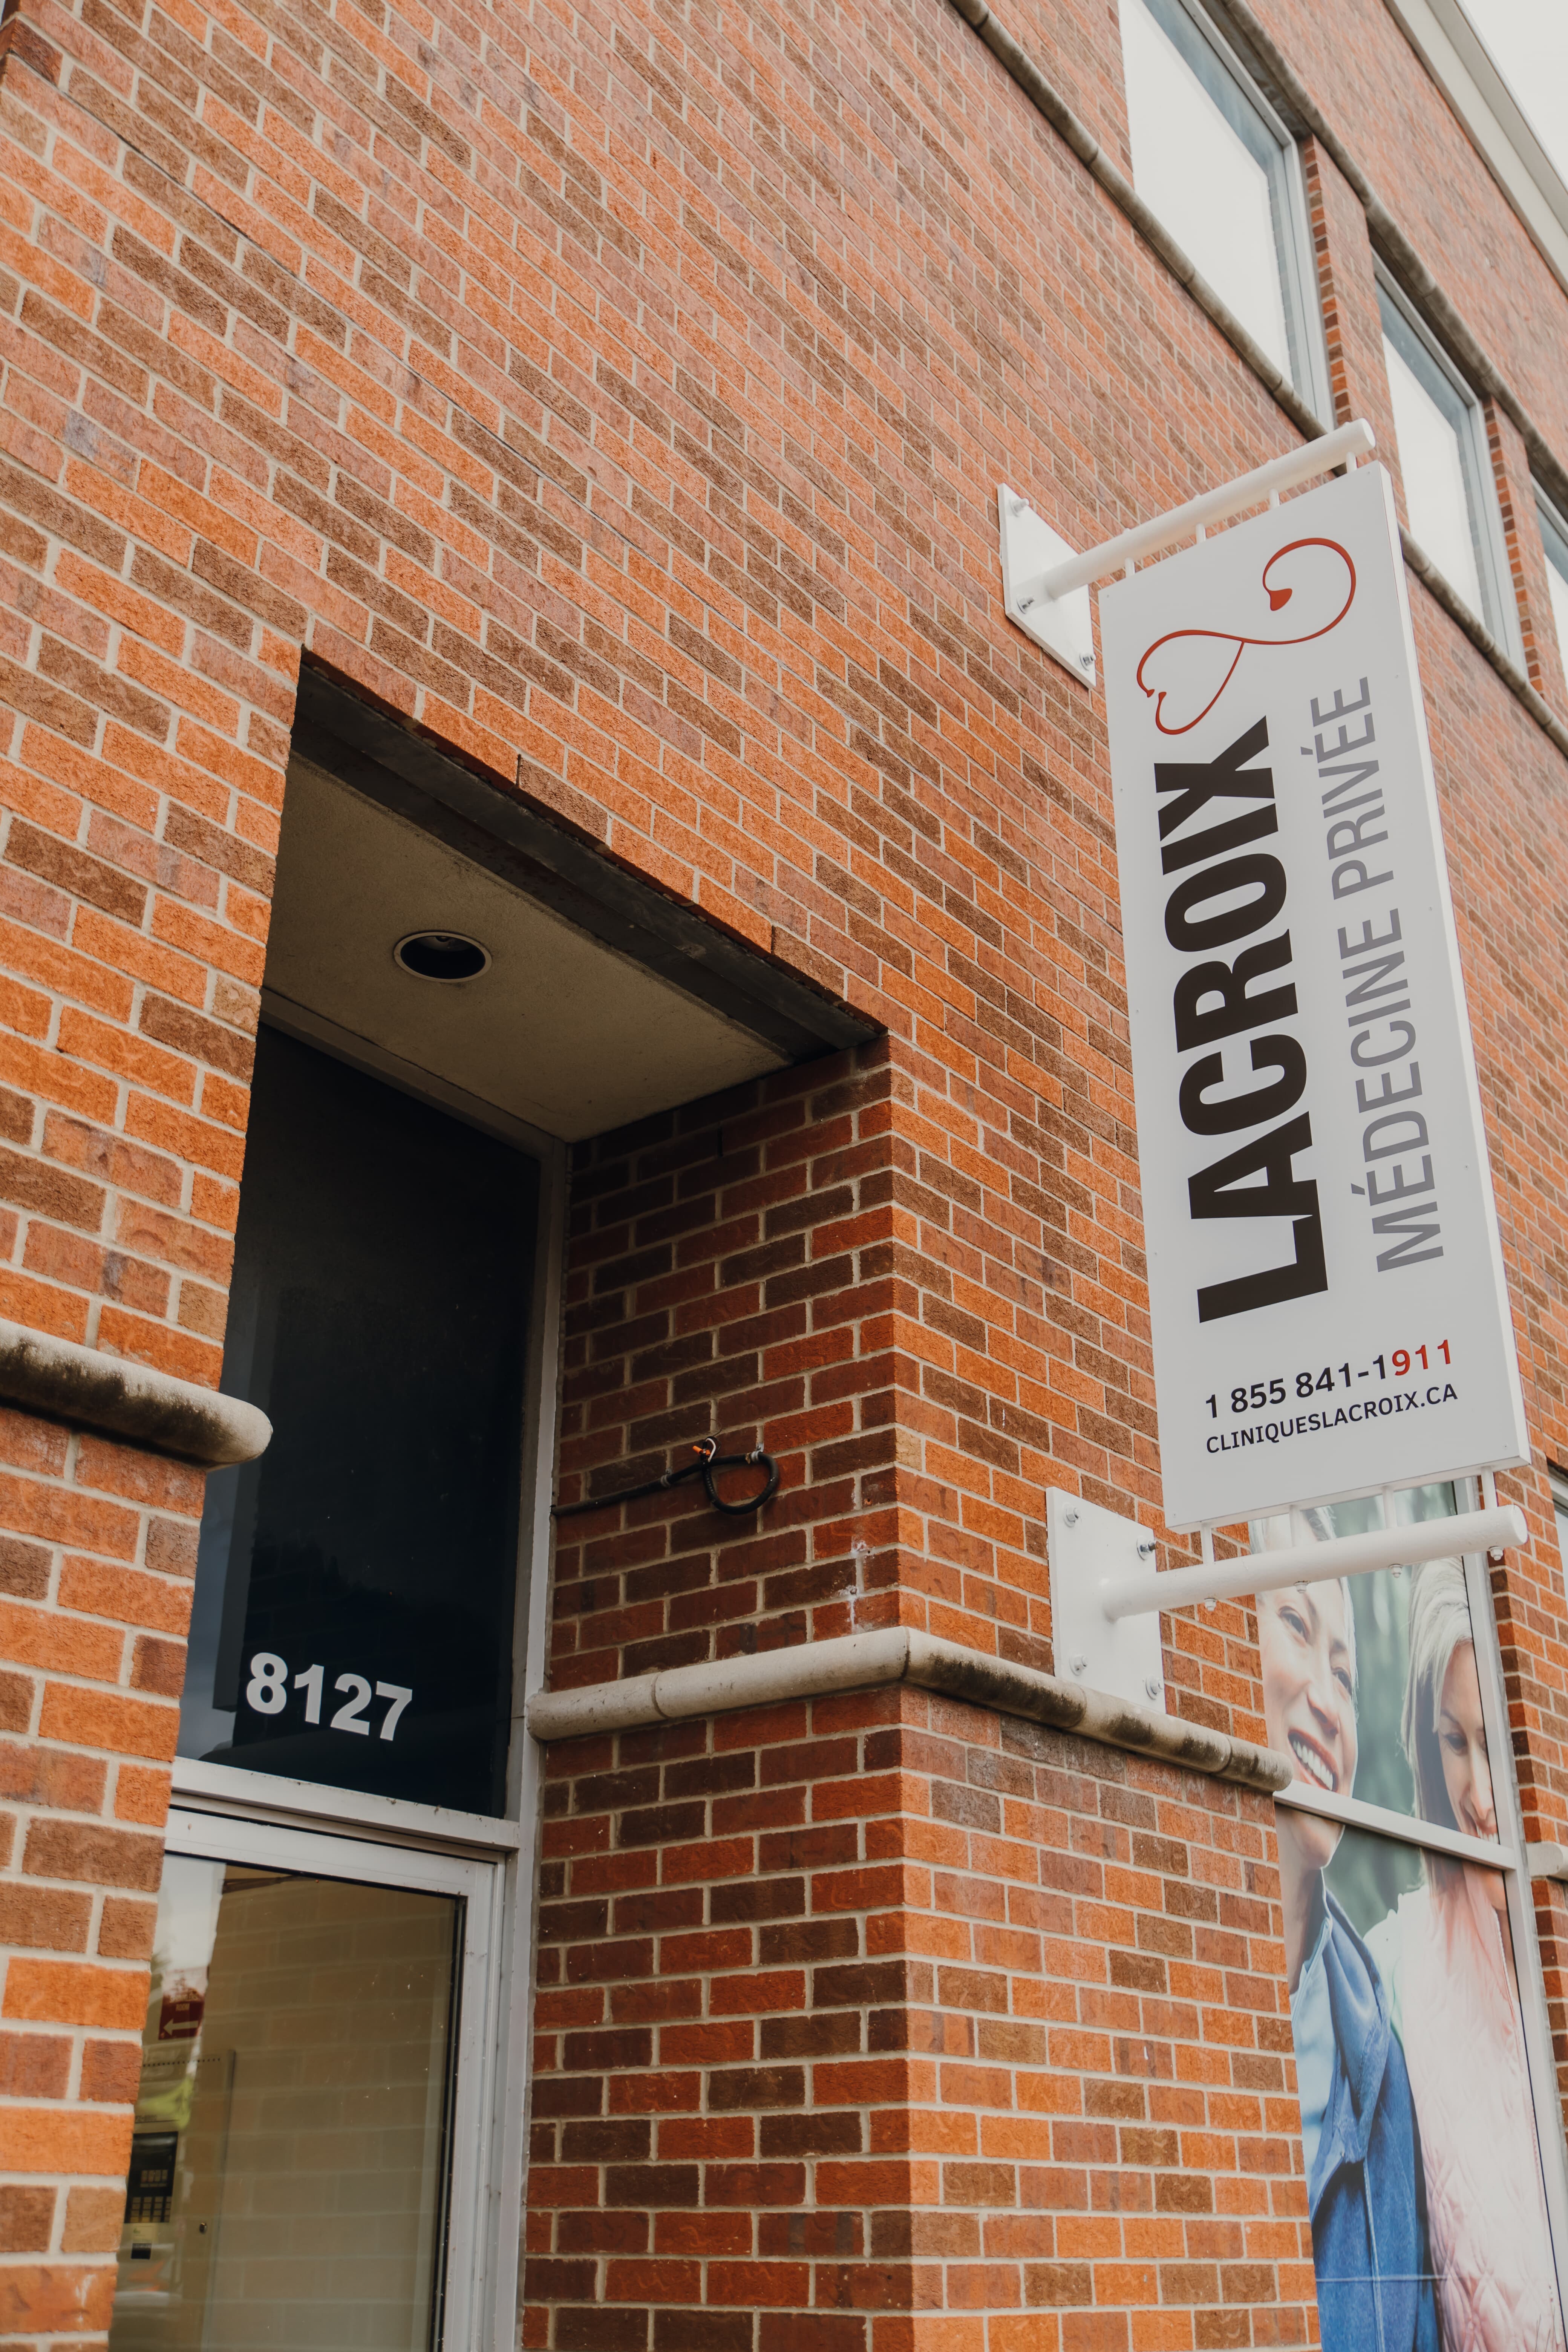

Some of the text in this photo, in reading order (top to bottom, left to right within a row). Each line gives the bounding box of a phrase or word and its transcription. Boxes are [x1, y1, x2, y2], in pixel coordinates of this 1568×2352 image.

[1300, 677, 1444, 1272] MÉDECINE PRIVÉE
[1154, 716, 1328, 1323] LACROIX
[1206, 1339, 1451, 1418] 1 855 841-1911
[1207, 1384, 1458, 1453] CLINIQUESLACROIX.CA
[246, 1652, 413, 1741] 8127
